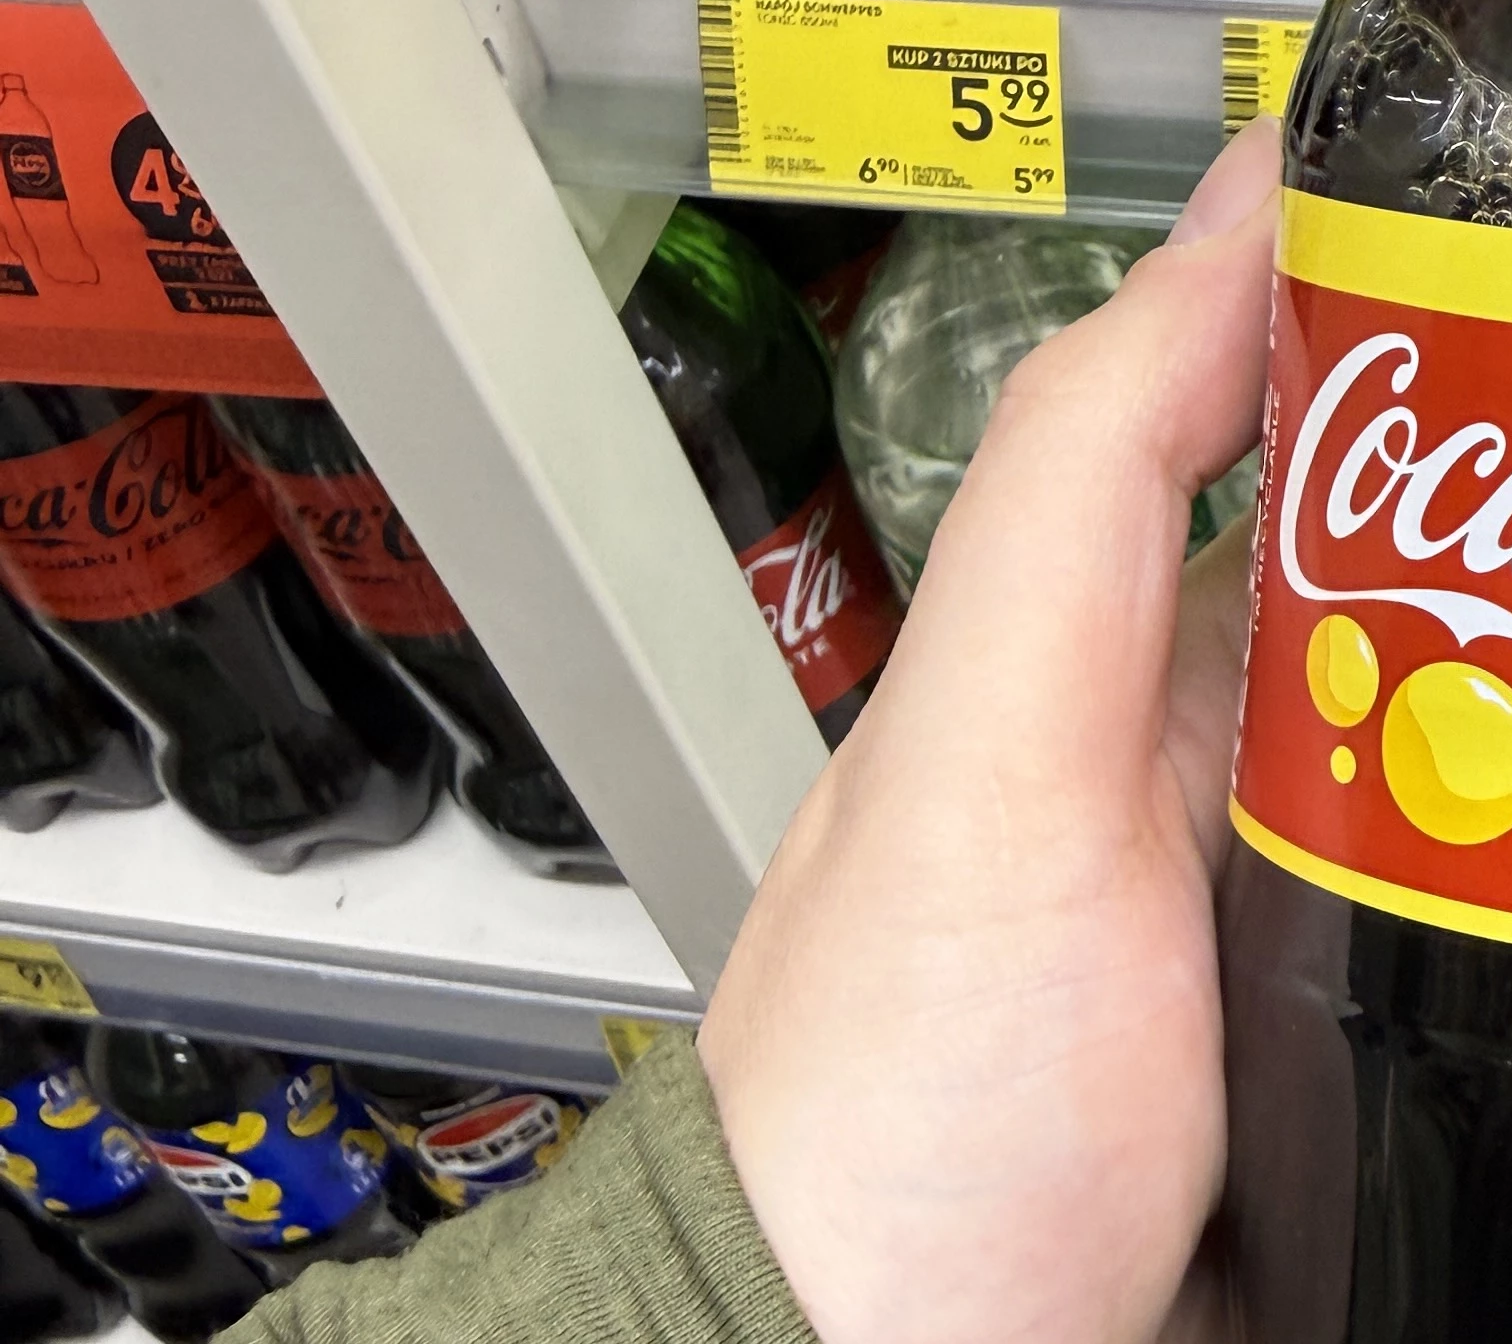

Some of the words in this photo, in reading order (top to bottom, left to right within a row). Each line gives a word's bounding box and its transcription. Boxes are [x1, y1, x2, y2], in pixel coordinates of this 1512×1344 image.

[892, 48, 929, 66] KUP
[932, 51, 942, 67] 2
[946, 51, 1011, 71] SZTUKI
[1016, 56, 1043, 73] PO
